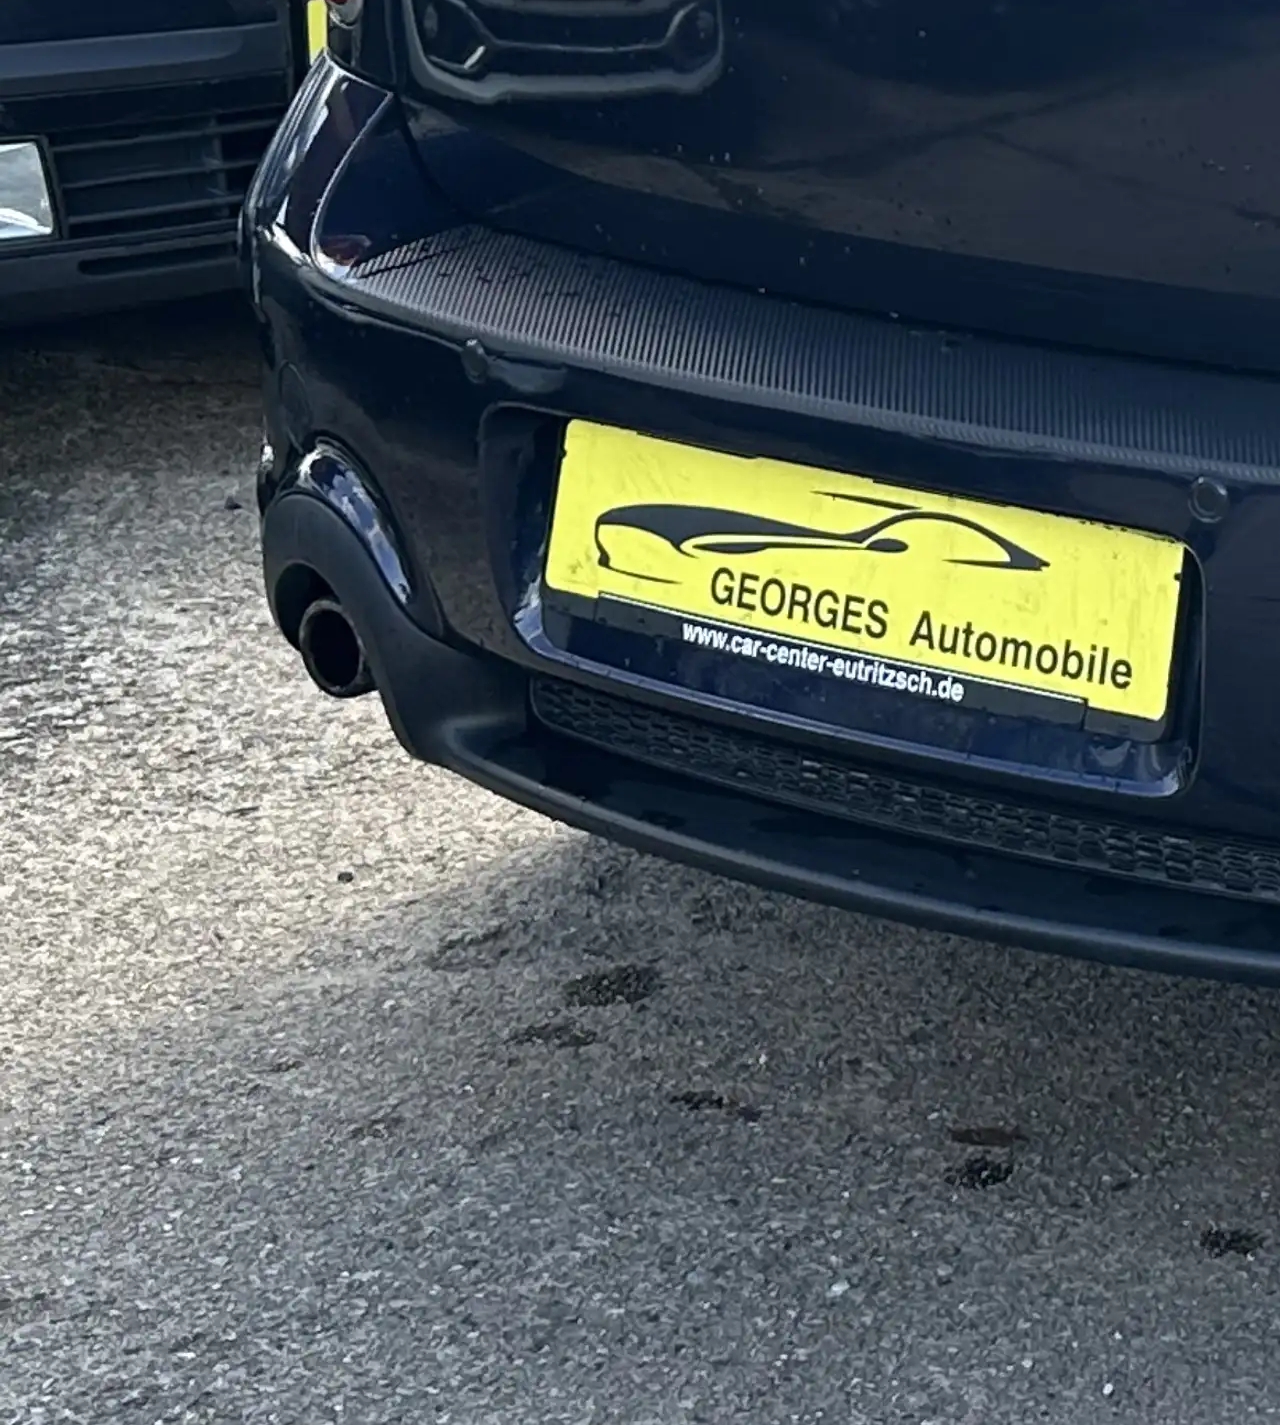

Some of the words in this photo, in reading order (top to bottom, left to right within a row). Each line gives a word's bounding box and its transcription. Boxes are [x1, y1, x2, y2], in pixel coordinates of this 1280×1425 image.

[682, 620, 965, 702] www.car-center-eutritzsch.de
[708, 566, 890, 639] GEORGES
[909, 610, 1133, 691] Automobile
